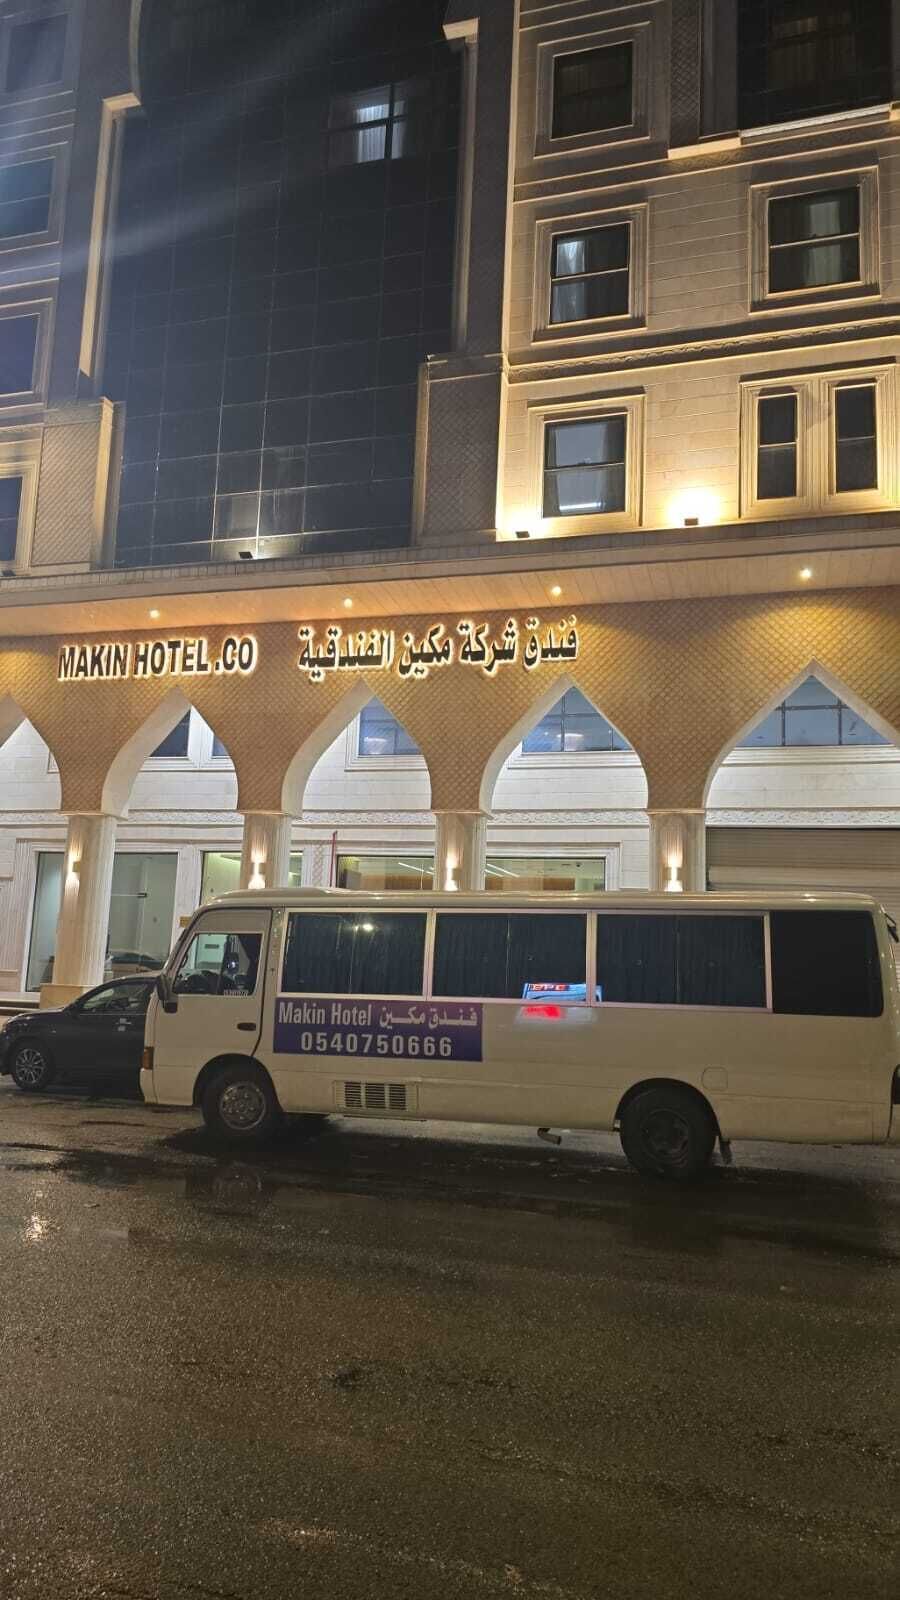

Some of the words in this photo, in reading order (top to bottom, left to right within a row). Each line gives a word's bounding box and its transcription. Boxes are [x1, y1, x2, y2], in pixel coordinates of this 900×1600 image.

[58, 644, 129, 679] MAKIN
[133, 639, 209, 676] HOTEL
[299, 626, 391, 678] الفندقية
[399, 625, 452, 675] مكين
[459, 620, 516, 672] شركة
[522, 615, 578, 668] فندق
[278, 1001, 325, 1024] Makin
[331, 1002, 372, 1026] Hotel
[379, 1005, 426, 1029] مكين
[428, 1006, 478, 1029] فندق
[301, 1031, 452, 1057] 0540750666
